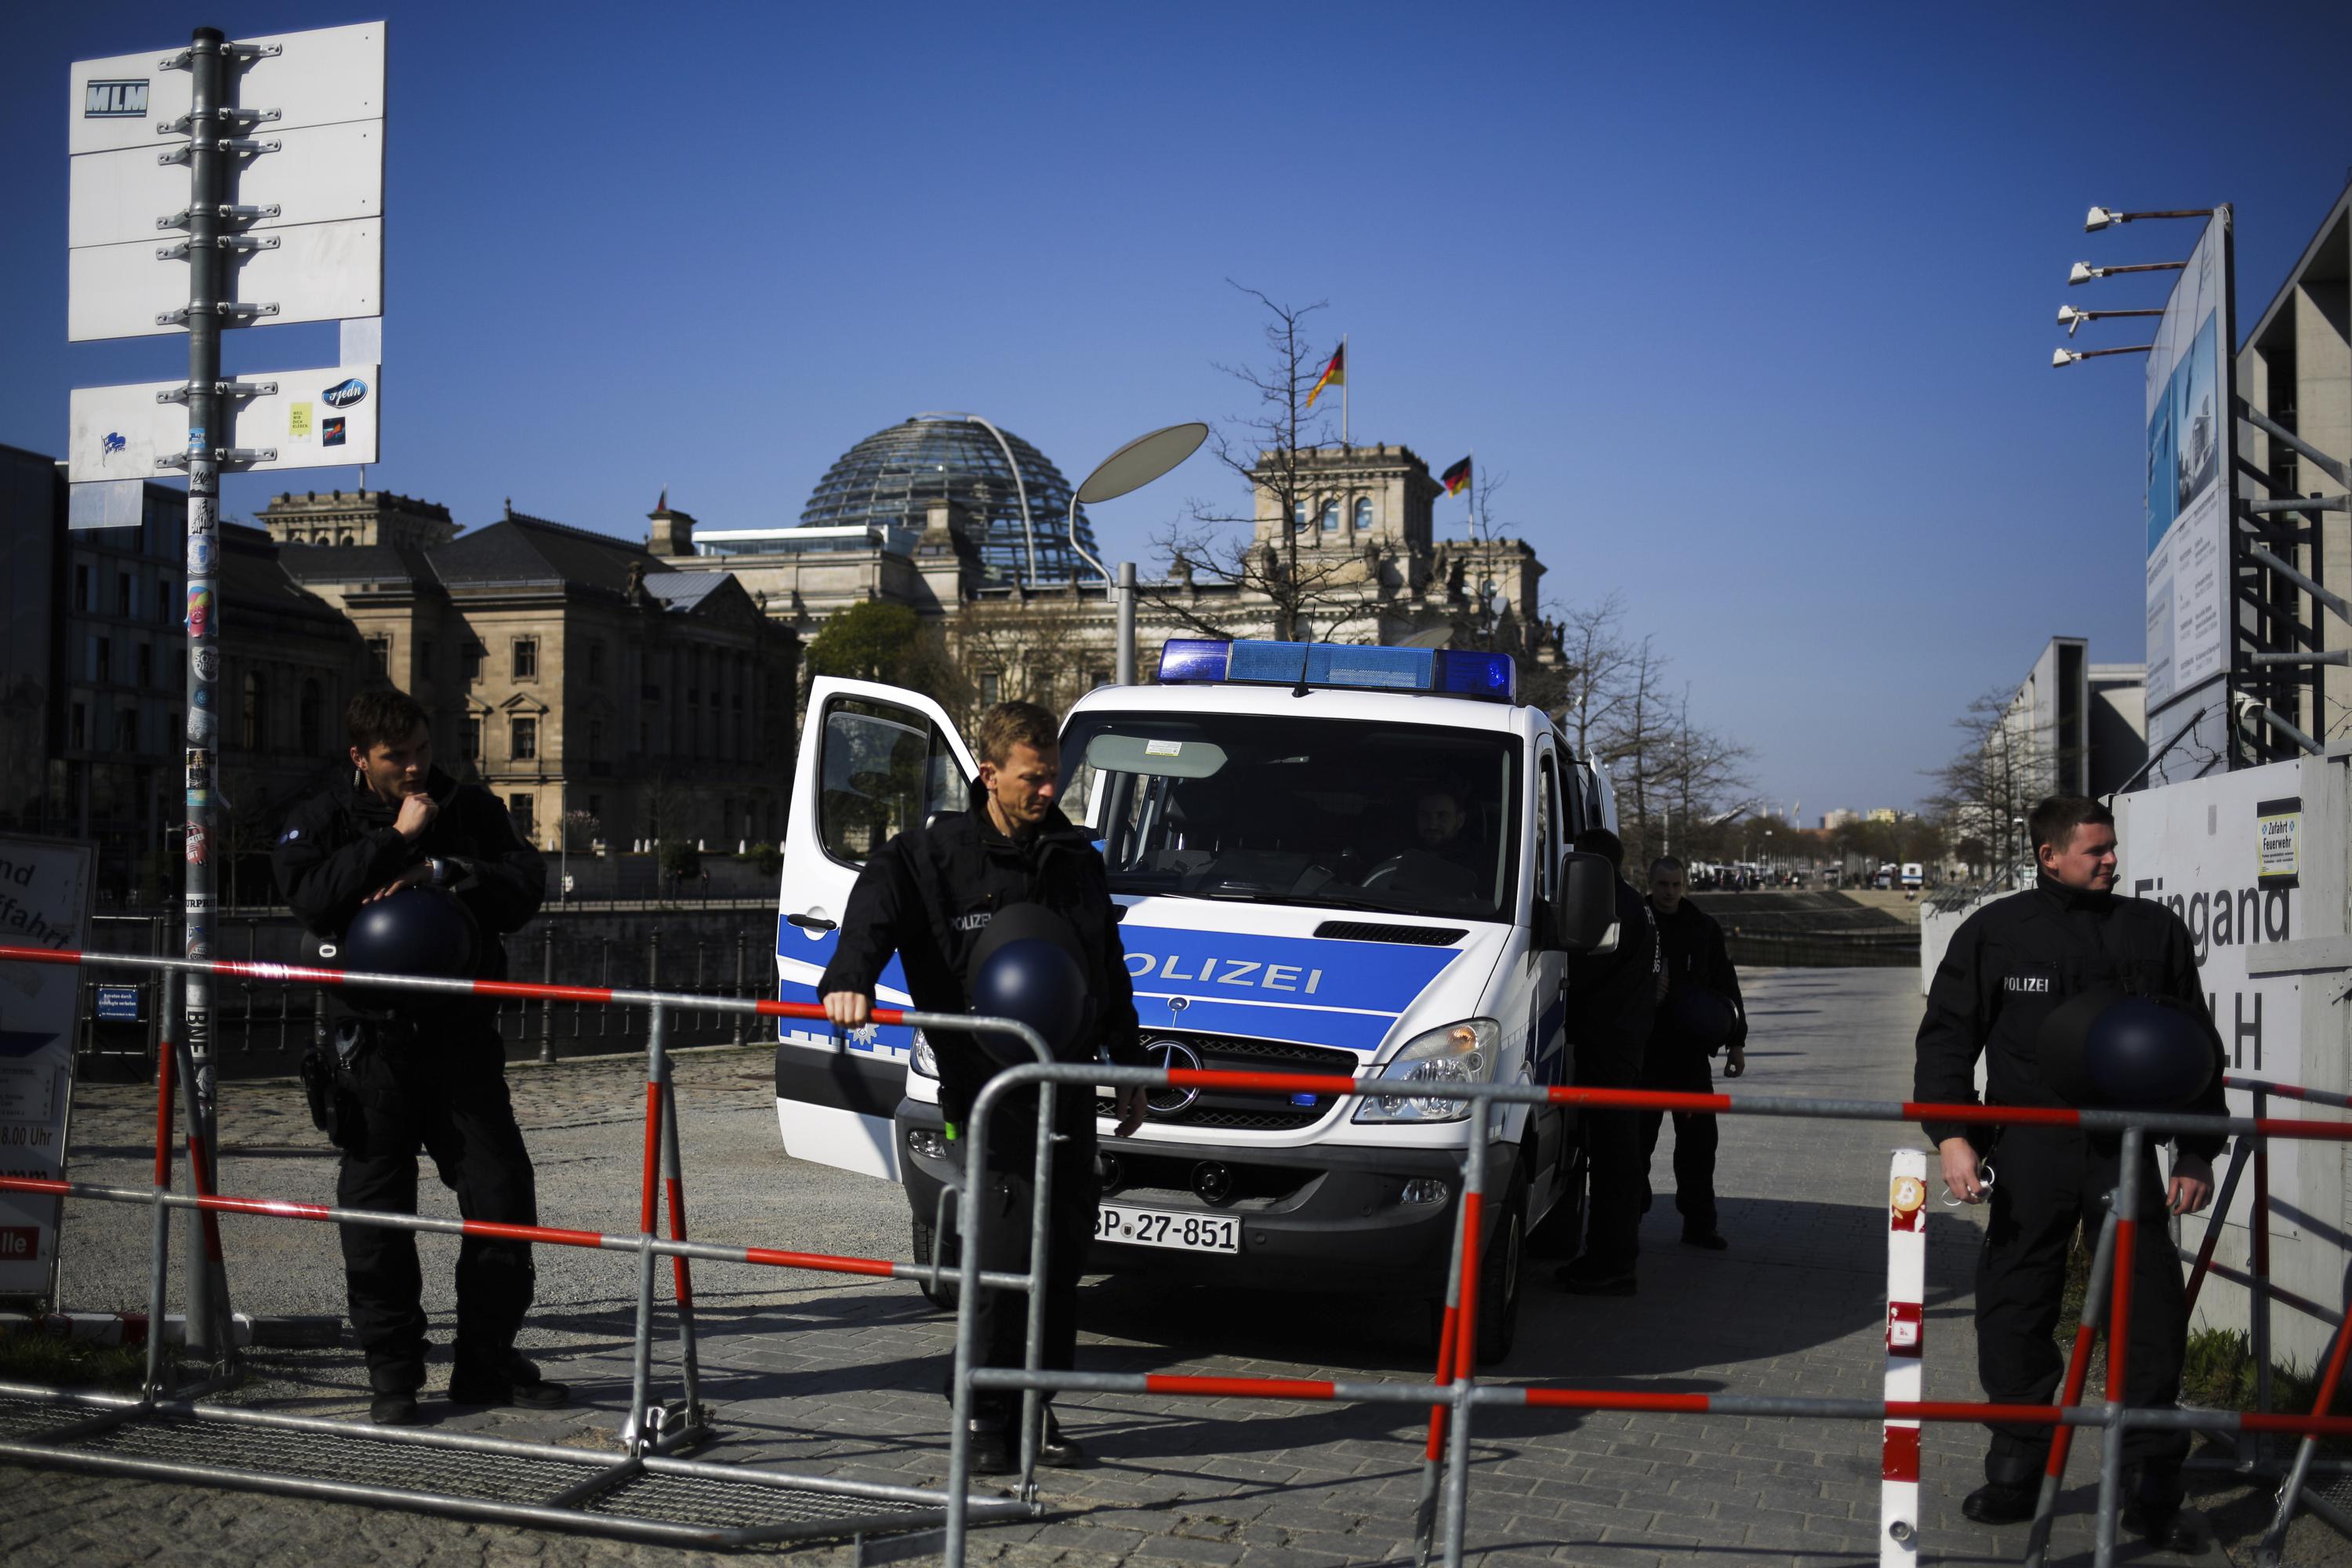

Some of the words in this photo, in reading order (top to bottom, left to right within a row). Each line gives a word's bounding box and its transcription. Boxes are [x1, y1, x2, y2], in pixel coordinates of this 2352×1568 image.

[85, 86, 149, 111] MLM
[2269, 820, 2288, 835] Zufahrt
[2263, 835, 2291, 851] Feuerwehr
[1123, 953, 1323, 994] OLIZEI
[2004, 977, 2049, 993] POLIZEI
[31, 1127, 53, 1146] Uhr
[1136, 1214, 1236, 1249] 27-851
